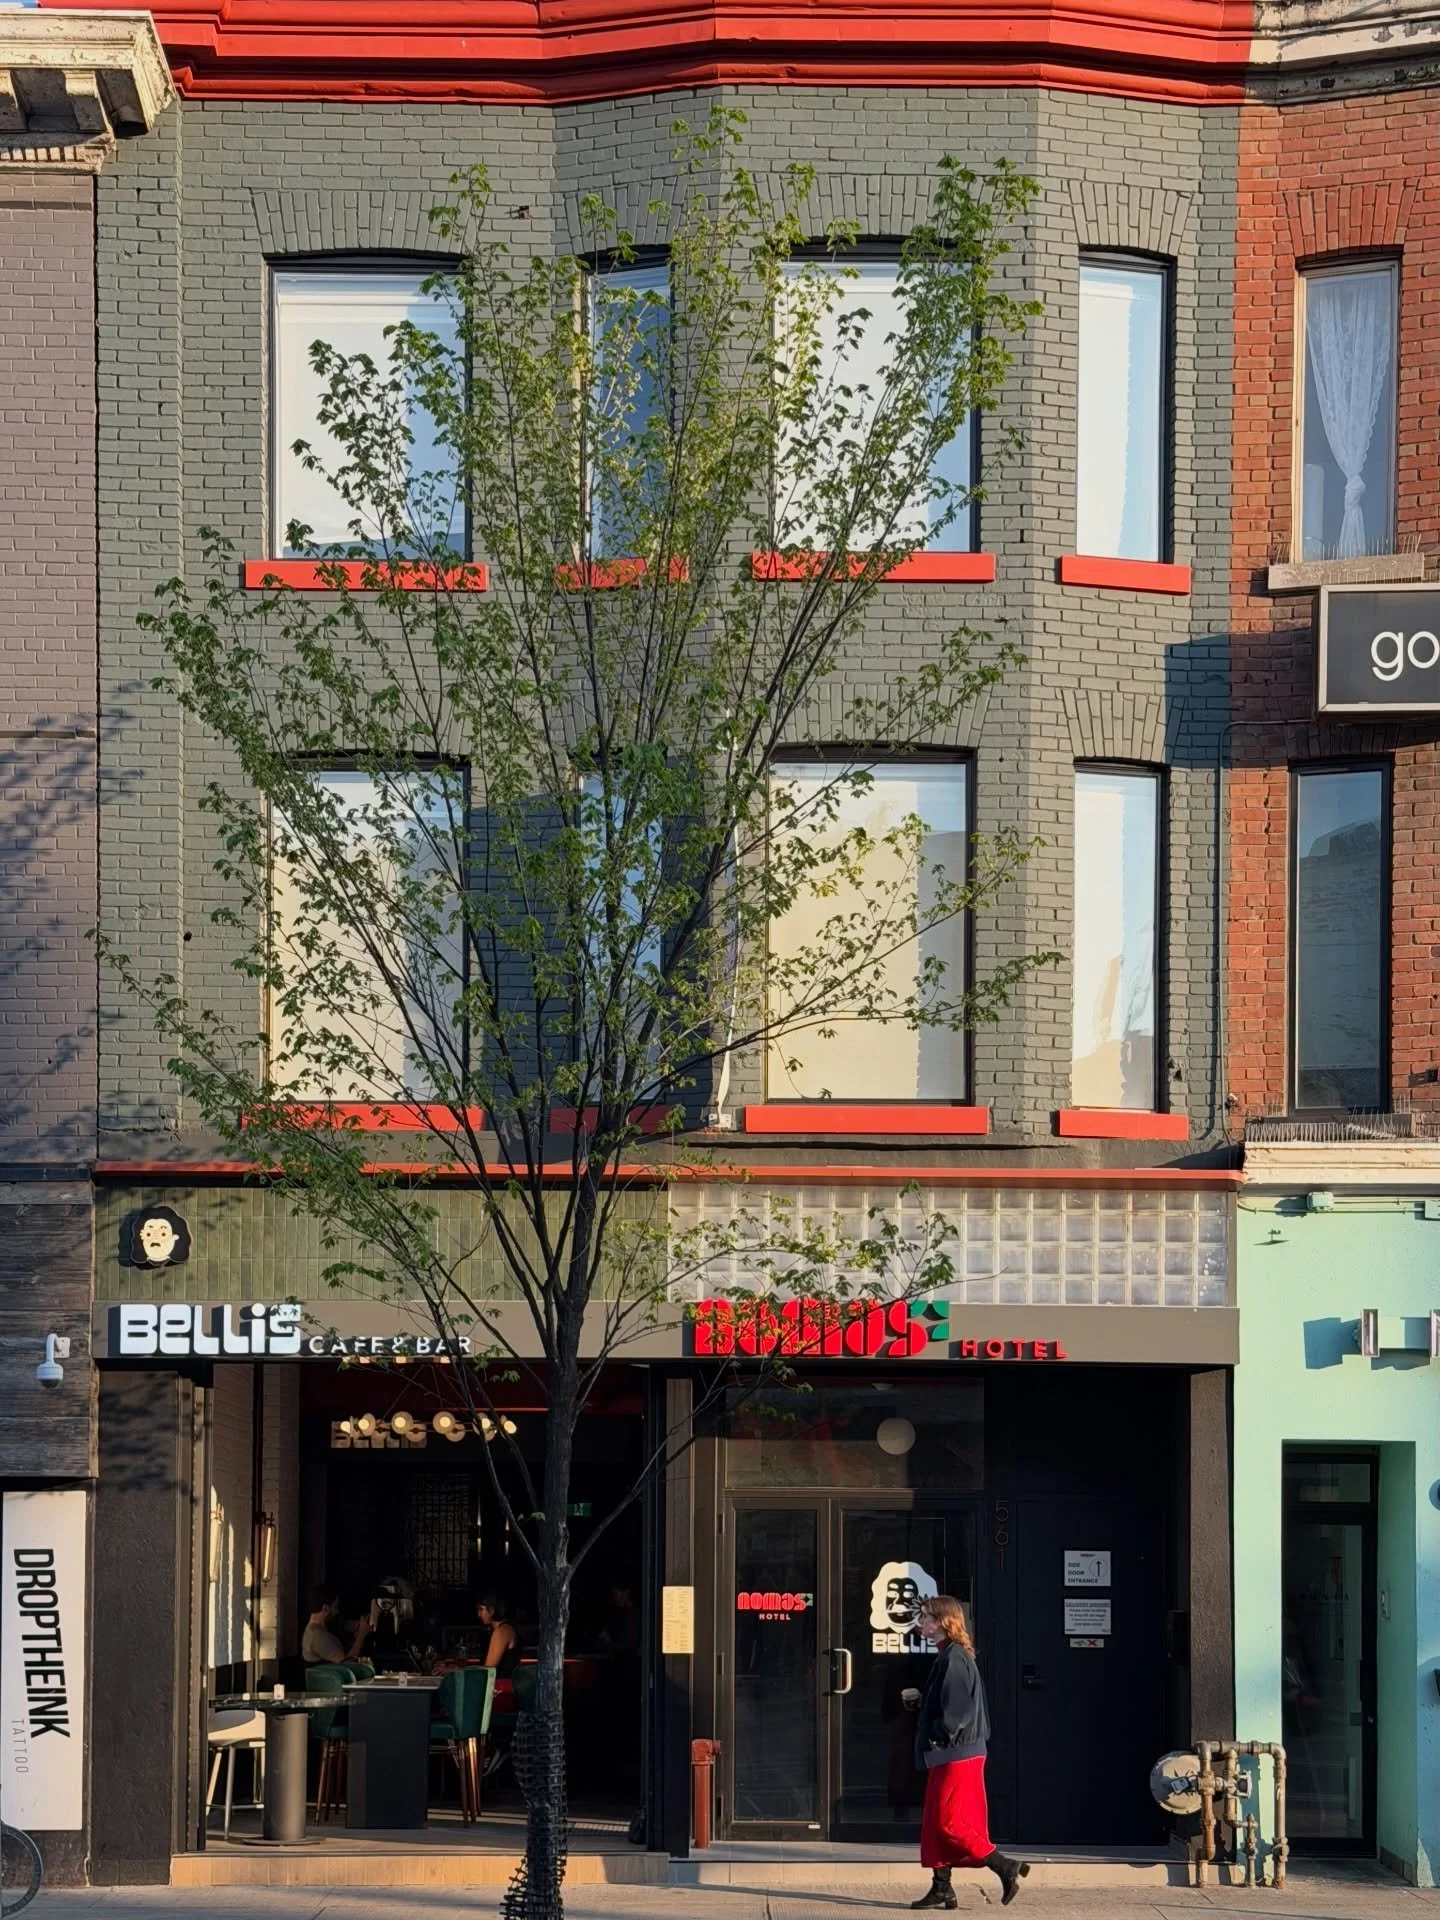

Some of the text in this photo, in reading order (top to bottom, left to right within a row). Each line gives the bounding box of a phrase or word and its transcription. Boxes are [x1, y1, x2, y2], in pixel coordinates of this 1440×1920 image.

[1371, 631, 1440, 681] go
[308, 1335, 384, 1354] CAFE
[416, 1335, 471, 1354] BAR
[962, 1339, 1068, 1359] HOTEL
[759, 1613, 791, 1621] HOTEL
[11, 1718, 29, 1773] TATTOO
